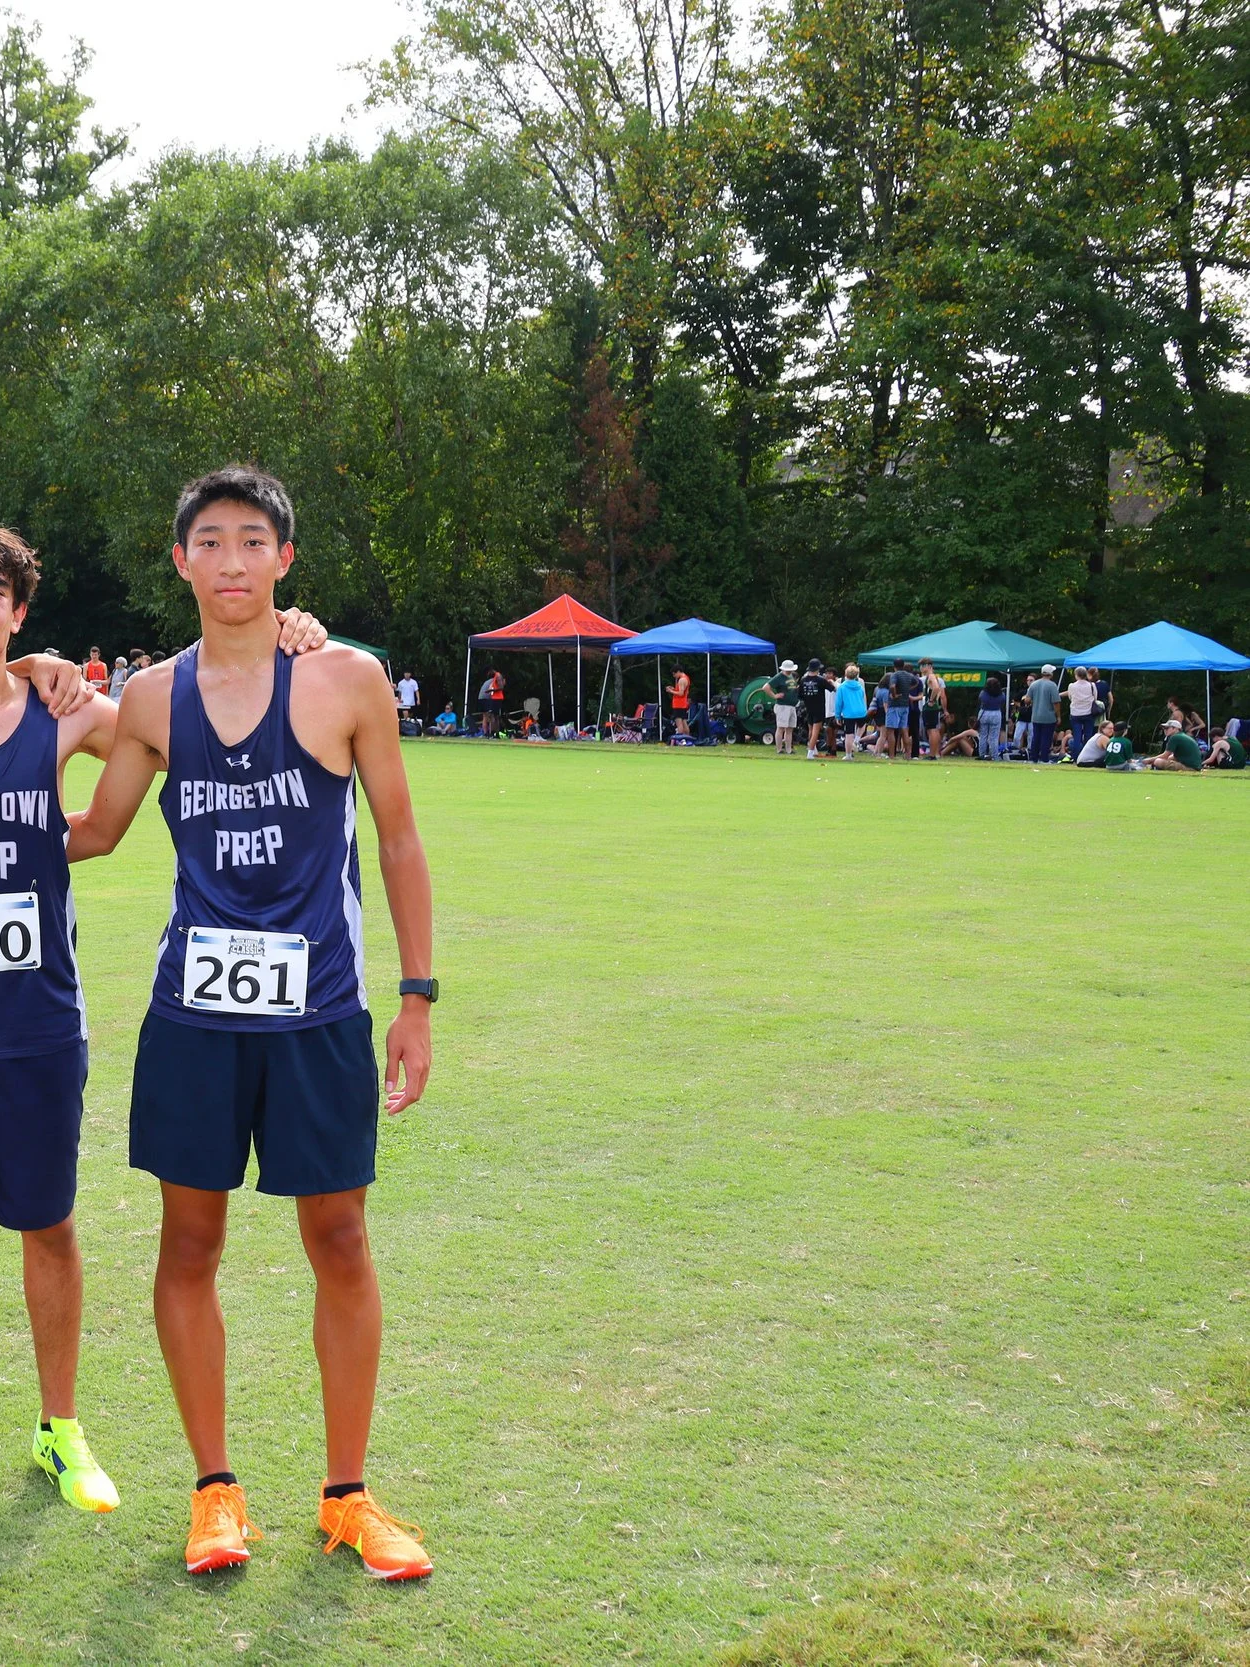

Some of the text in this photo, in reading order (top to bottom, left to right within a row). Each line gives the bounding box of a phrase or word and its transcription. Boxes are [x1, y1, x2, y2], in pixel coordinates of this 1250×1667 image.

[1107, 741, 1122, 753] 49
[215, 824, 283, 871] PREP
[194, 956, 294, 1005] 261
